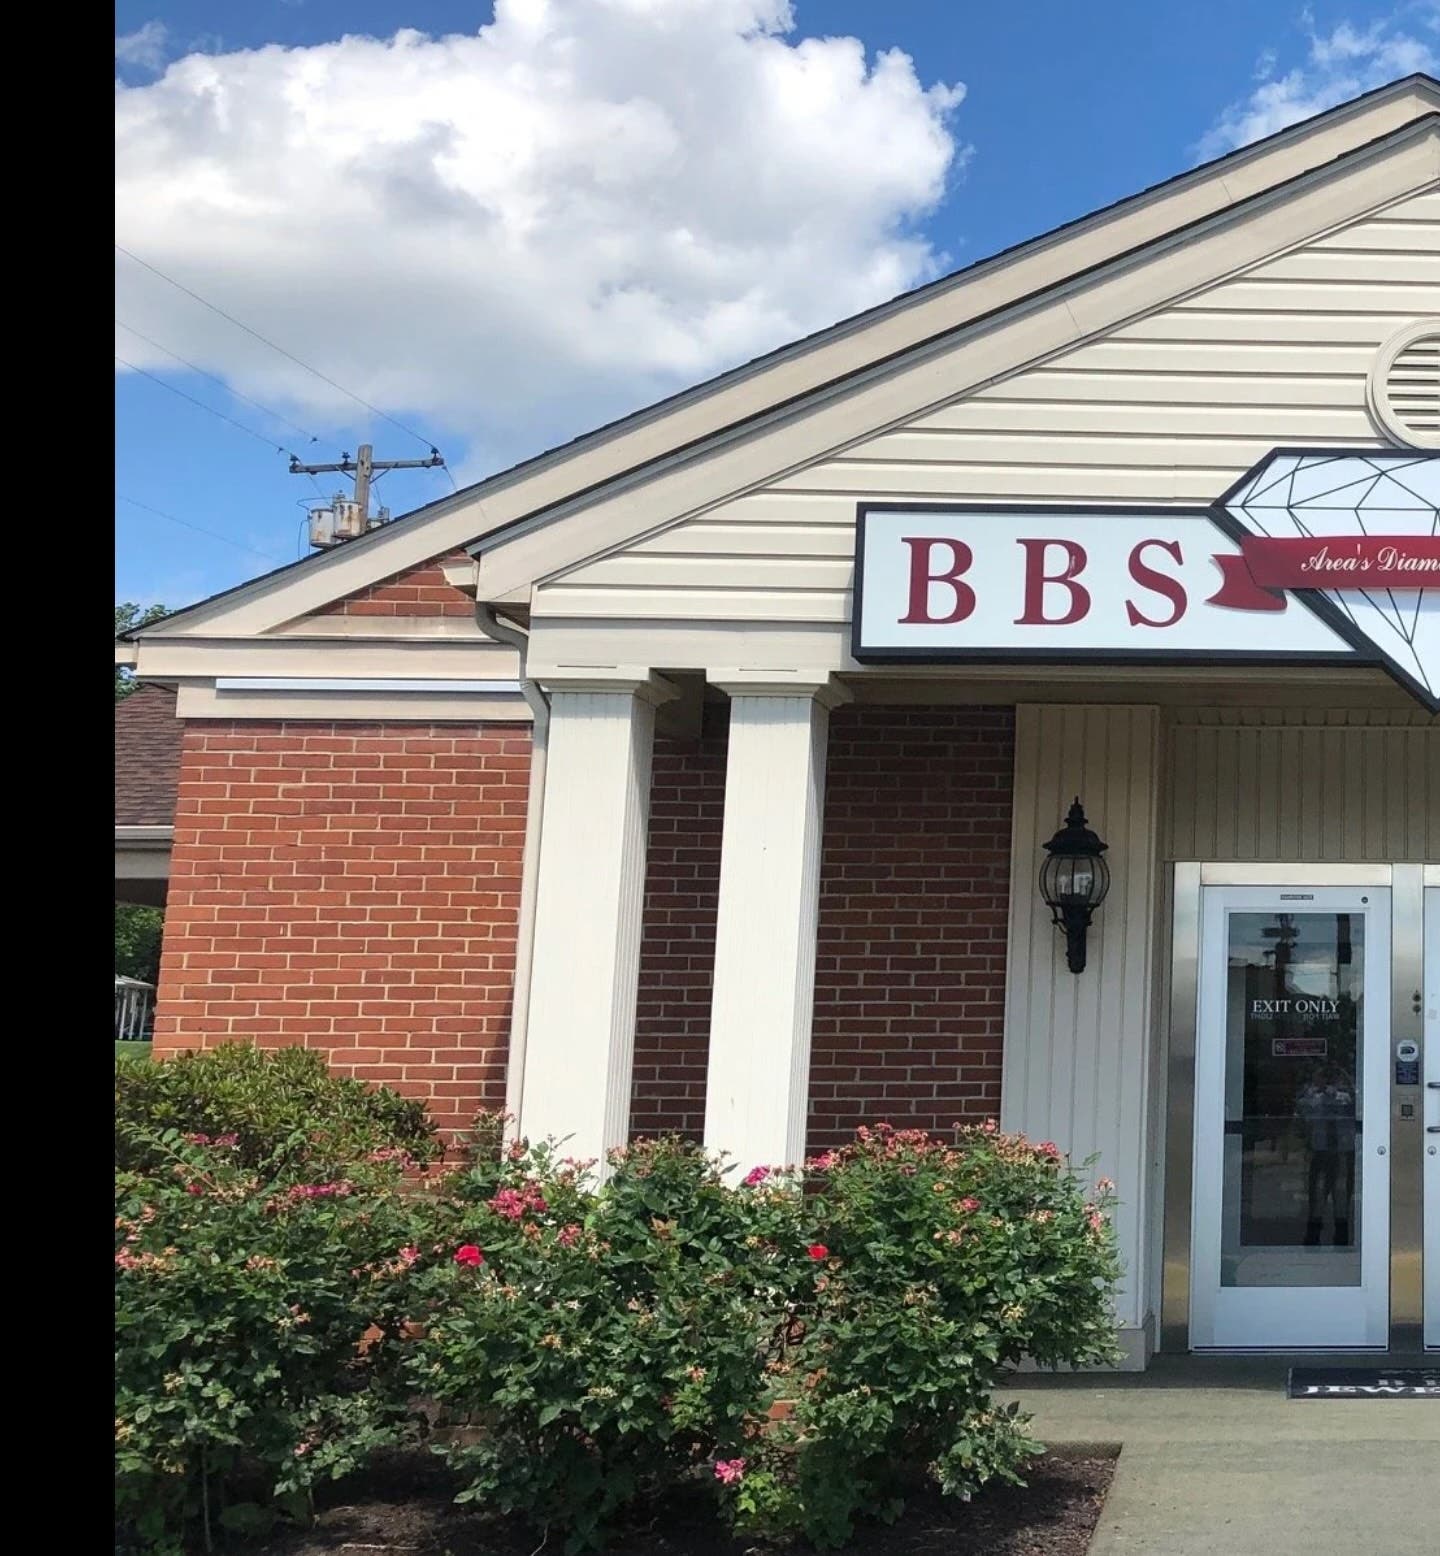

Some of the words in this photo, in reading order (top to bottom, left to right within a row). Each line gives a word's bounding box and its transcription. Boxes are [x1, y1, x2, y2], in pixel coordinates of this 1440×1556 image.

[1301, 544, 1374, 571] Area's
[1253, 1000, 1291, 1013] EXIT
[1295, 1000, 1340, 1013] ONLY
